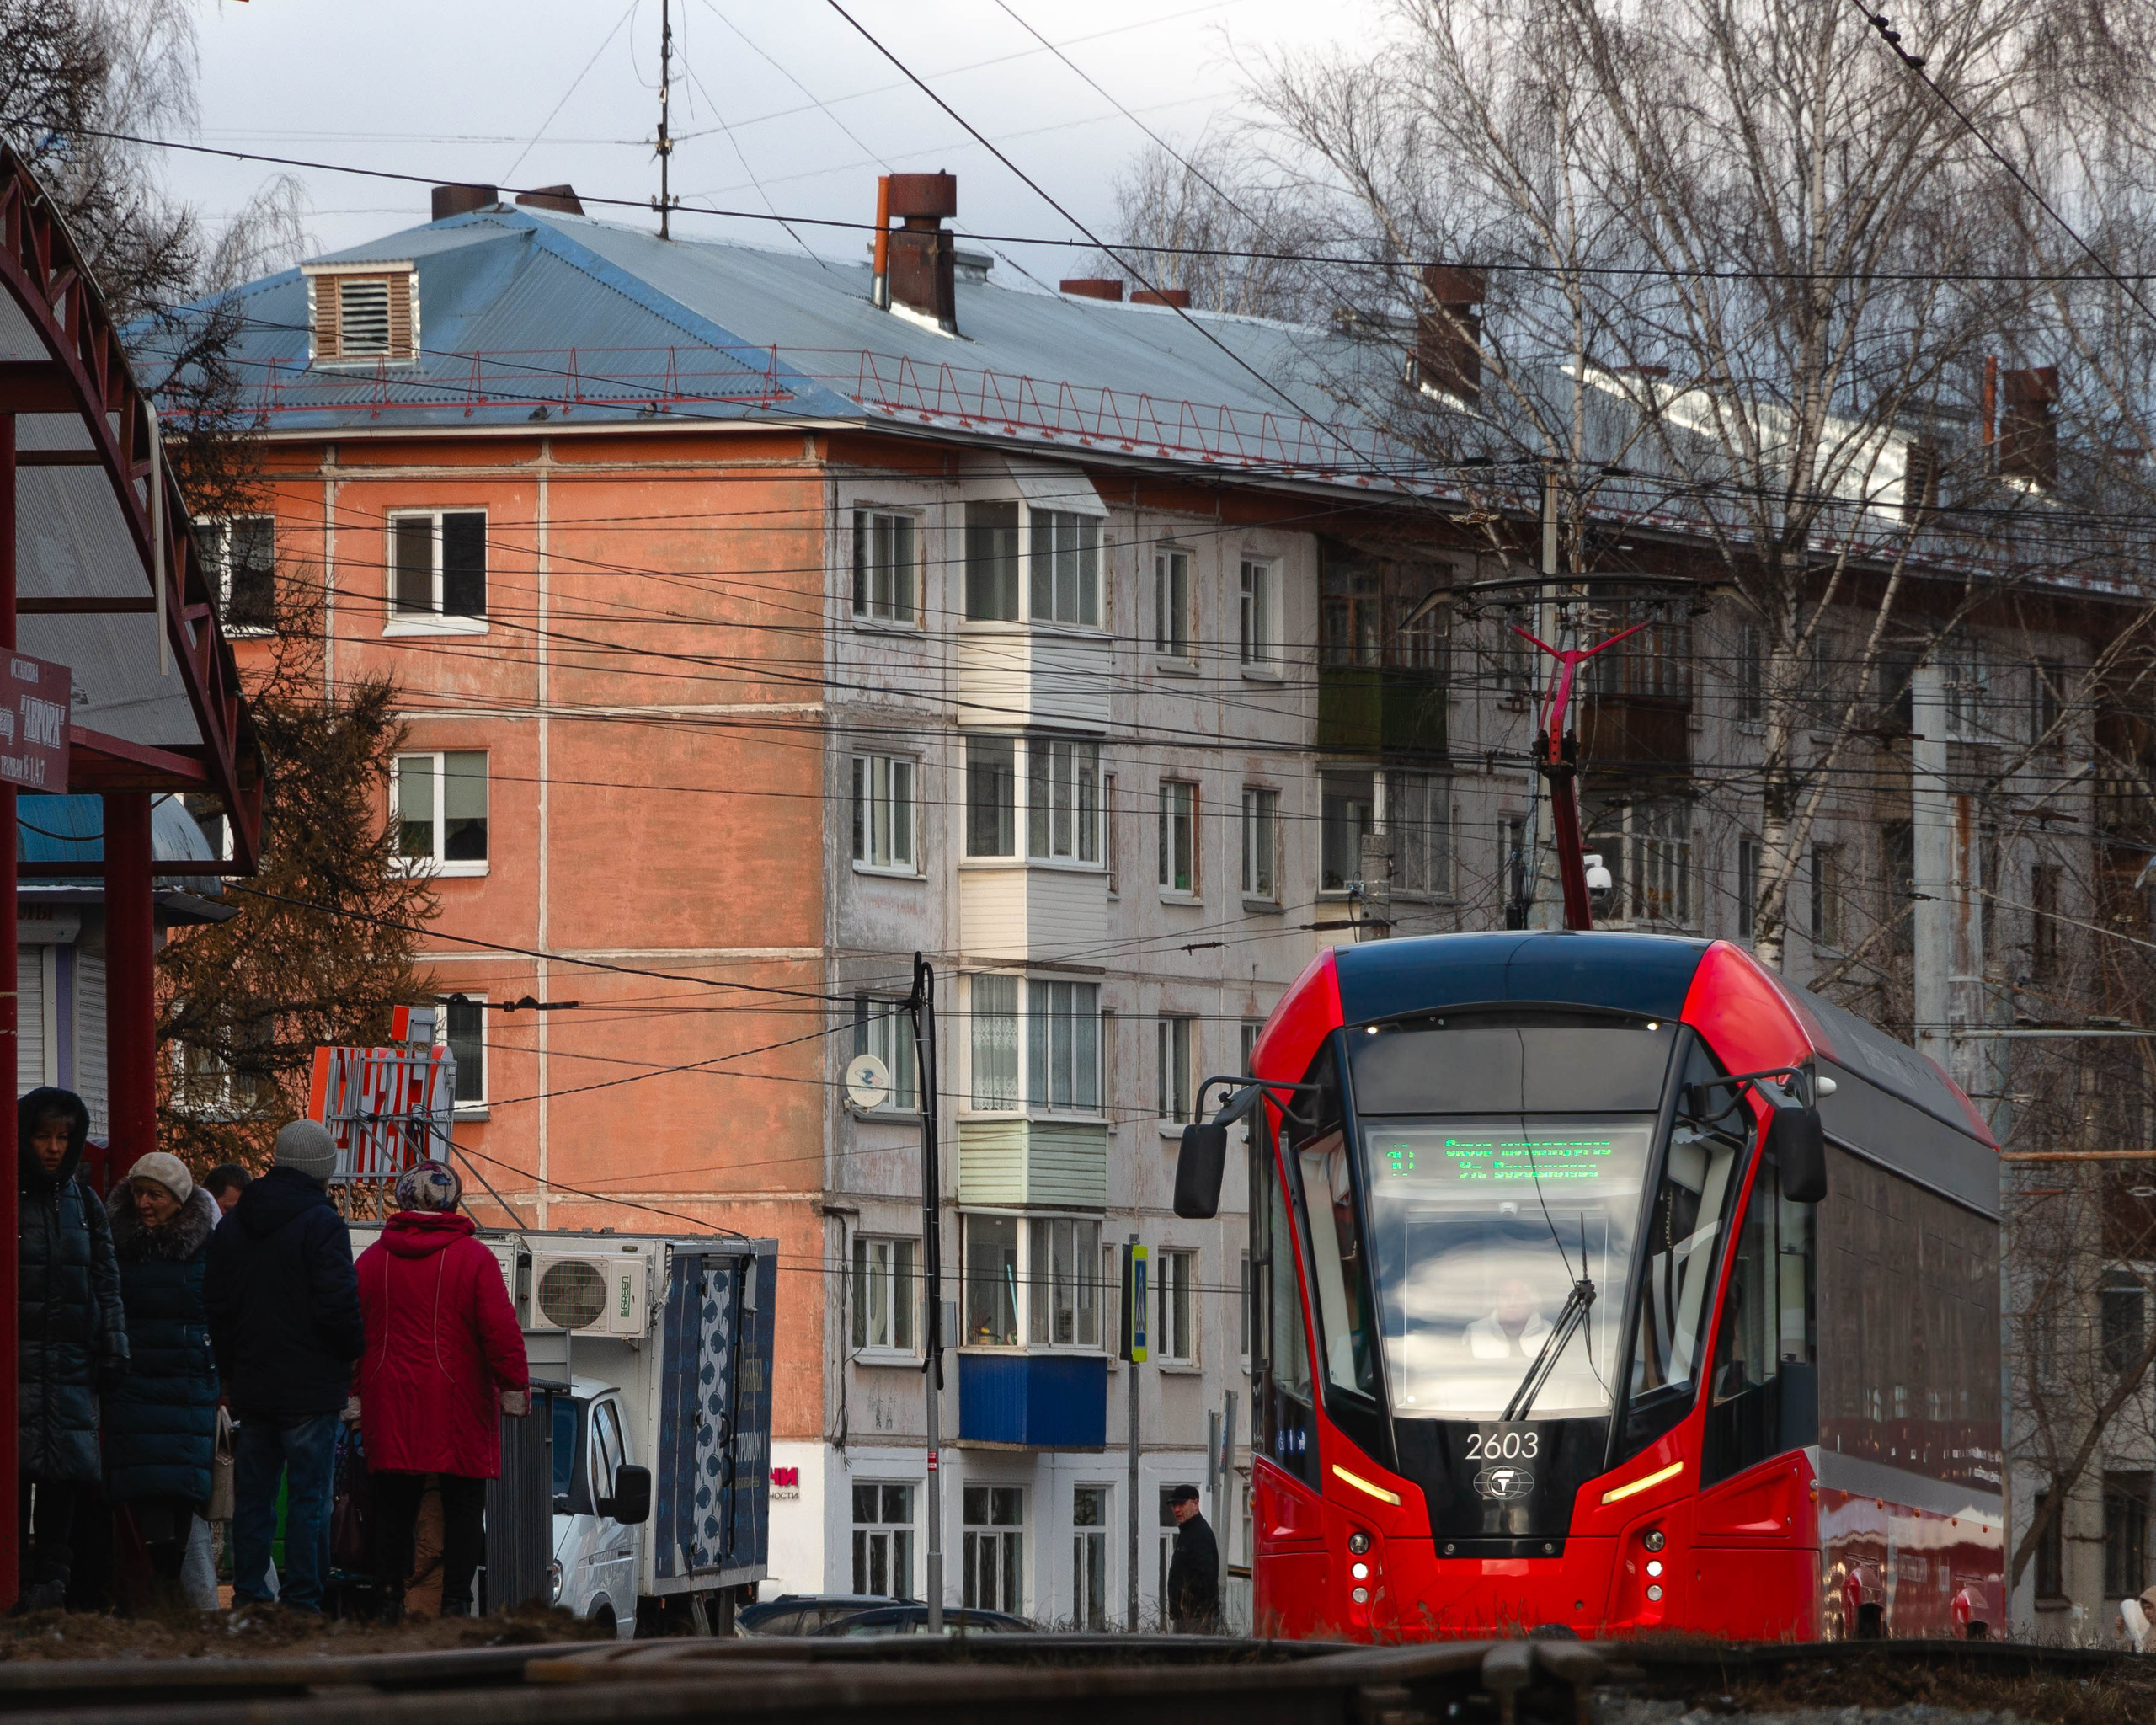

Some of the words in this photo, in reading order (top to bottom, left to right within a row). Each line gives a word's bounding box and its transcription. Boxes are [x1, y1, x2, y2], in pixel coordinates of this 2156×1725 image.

[19, 695, 66, 750] "АВРОРА"
[621, 1275, 630, 1310] GREEN
[1465, 1432, 1539, 1460] 2603
